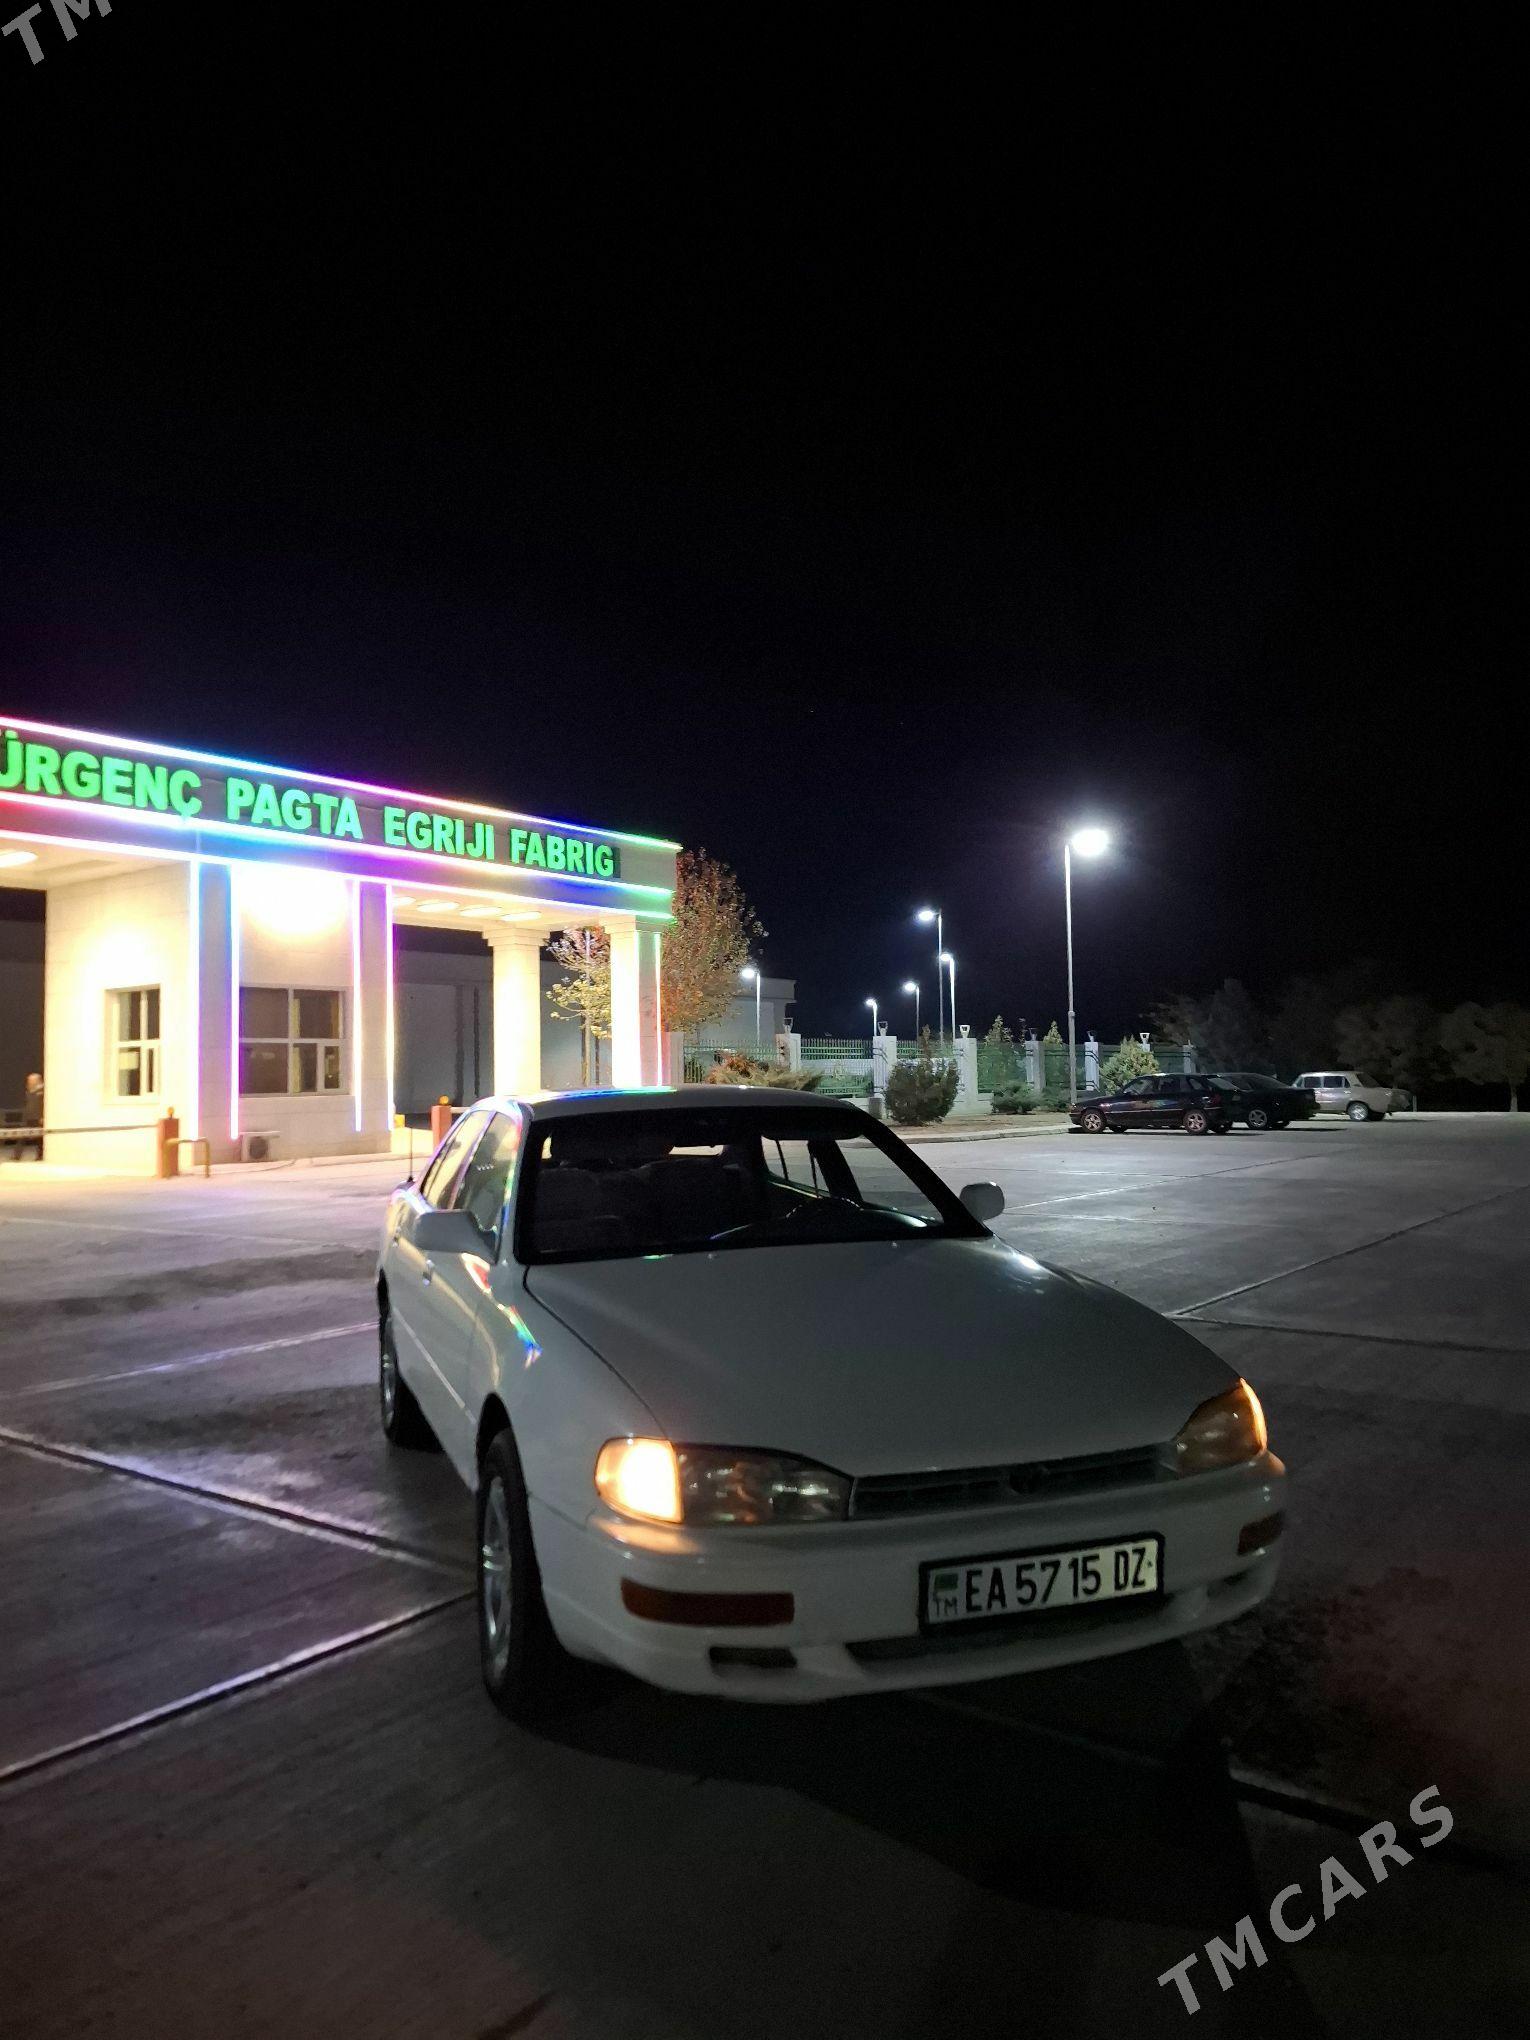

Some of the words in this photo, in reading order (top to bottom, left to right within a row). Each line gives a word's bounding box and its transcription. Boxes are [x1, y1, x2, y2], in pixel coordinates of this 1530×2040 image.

[227, 776, 363, 840] PAGTA
[384, 806, 495, 860] EGRIJI
[511, 828, 614, 877] FABRIG
[966, 1567, 1007, 1613] EA
[1016, 1555, 1101, 1605] 5715
[1114, 1548, 1147, 1591] DZ
